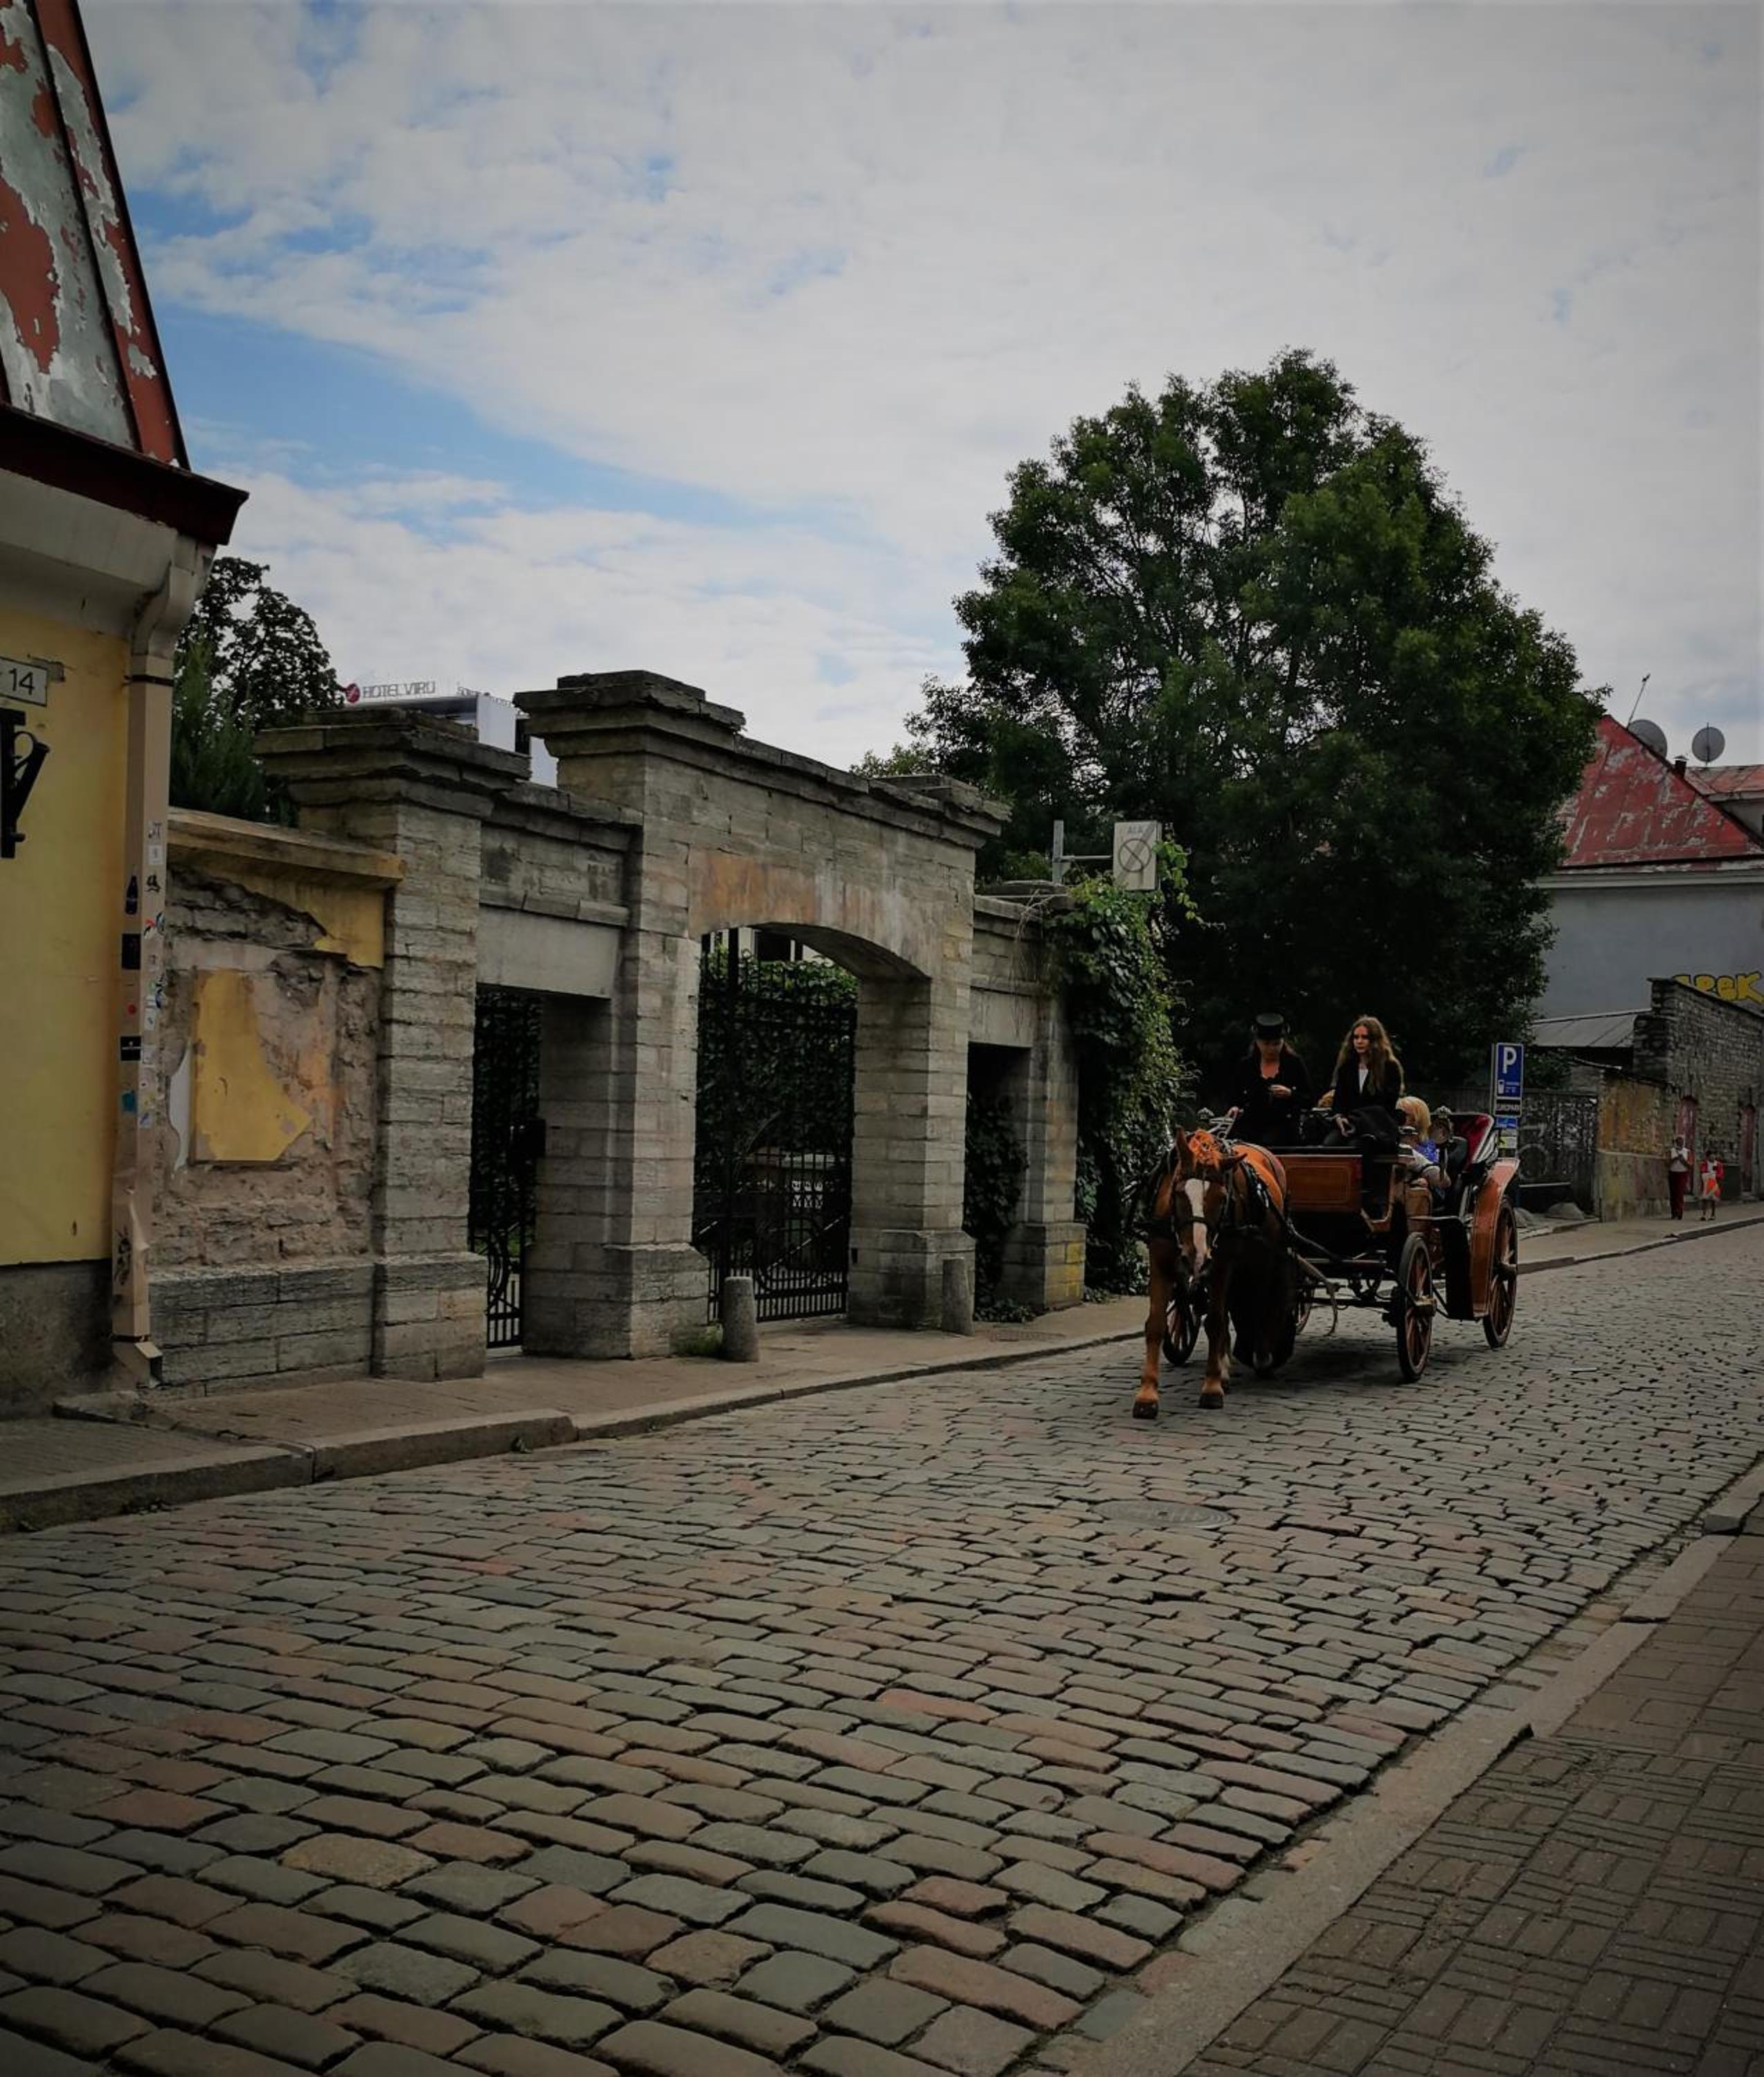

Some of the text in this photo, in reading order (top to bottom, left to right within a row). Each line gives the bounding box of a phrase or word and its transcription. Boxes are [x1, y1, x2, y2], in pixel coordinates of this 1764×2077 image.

[9, 668, 35, 695] 14
[361, 681, 436, 699] HOTEL VIRU
[1502, 1046, 1518, 1074] P
